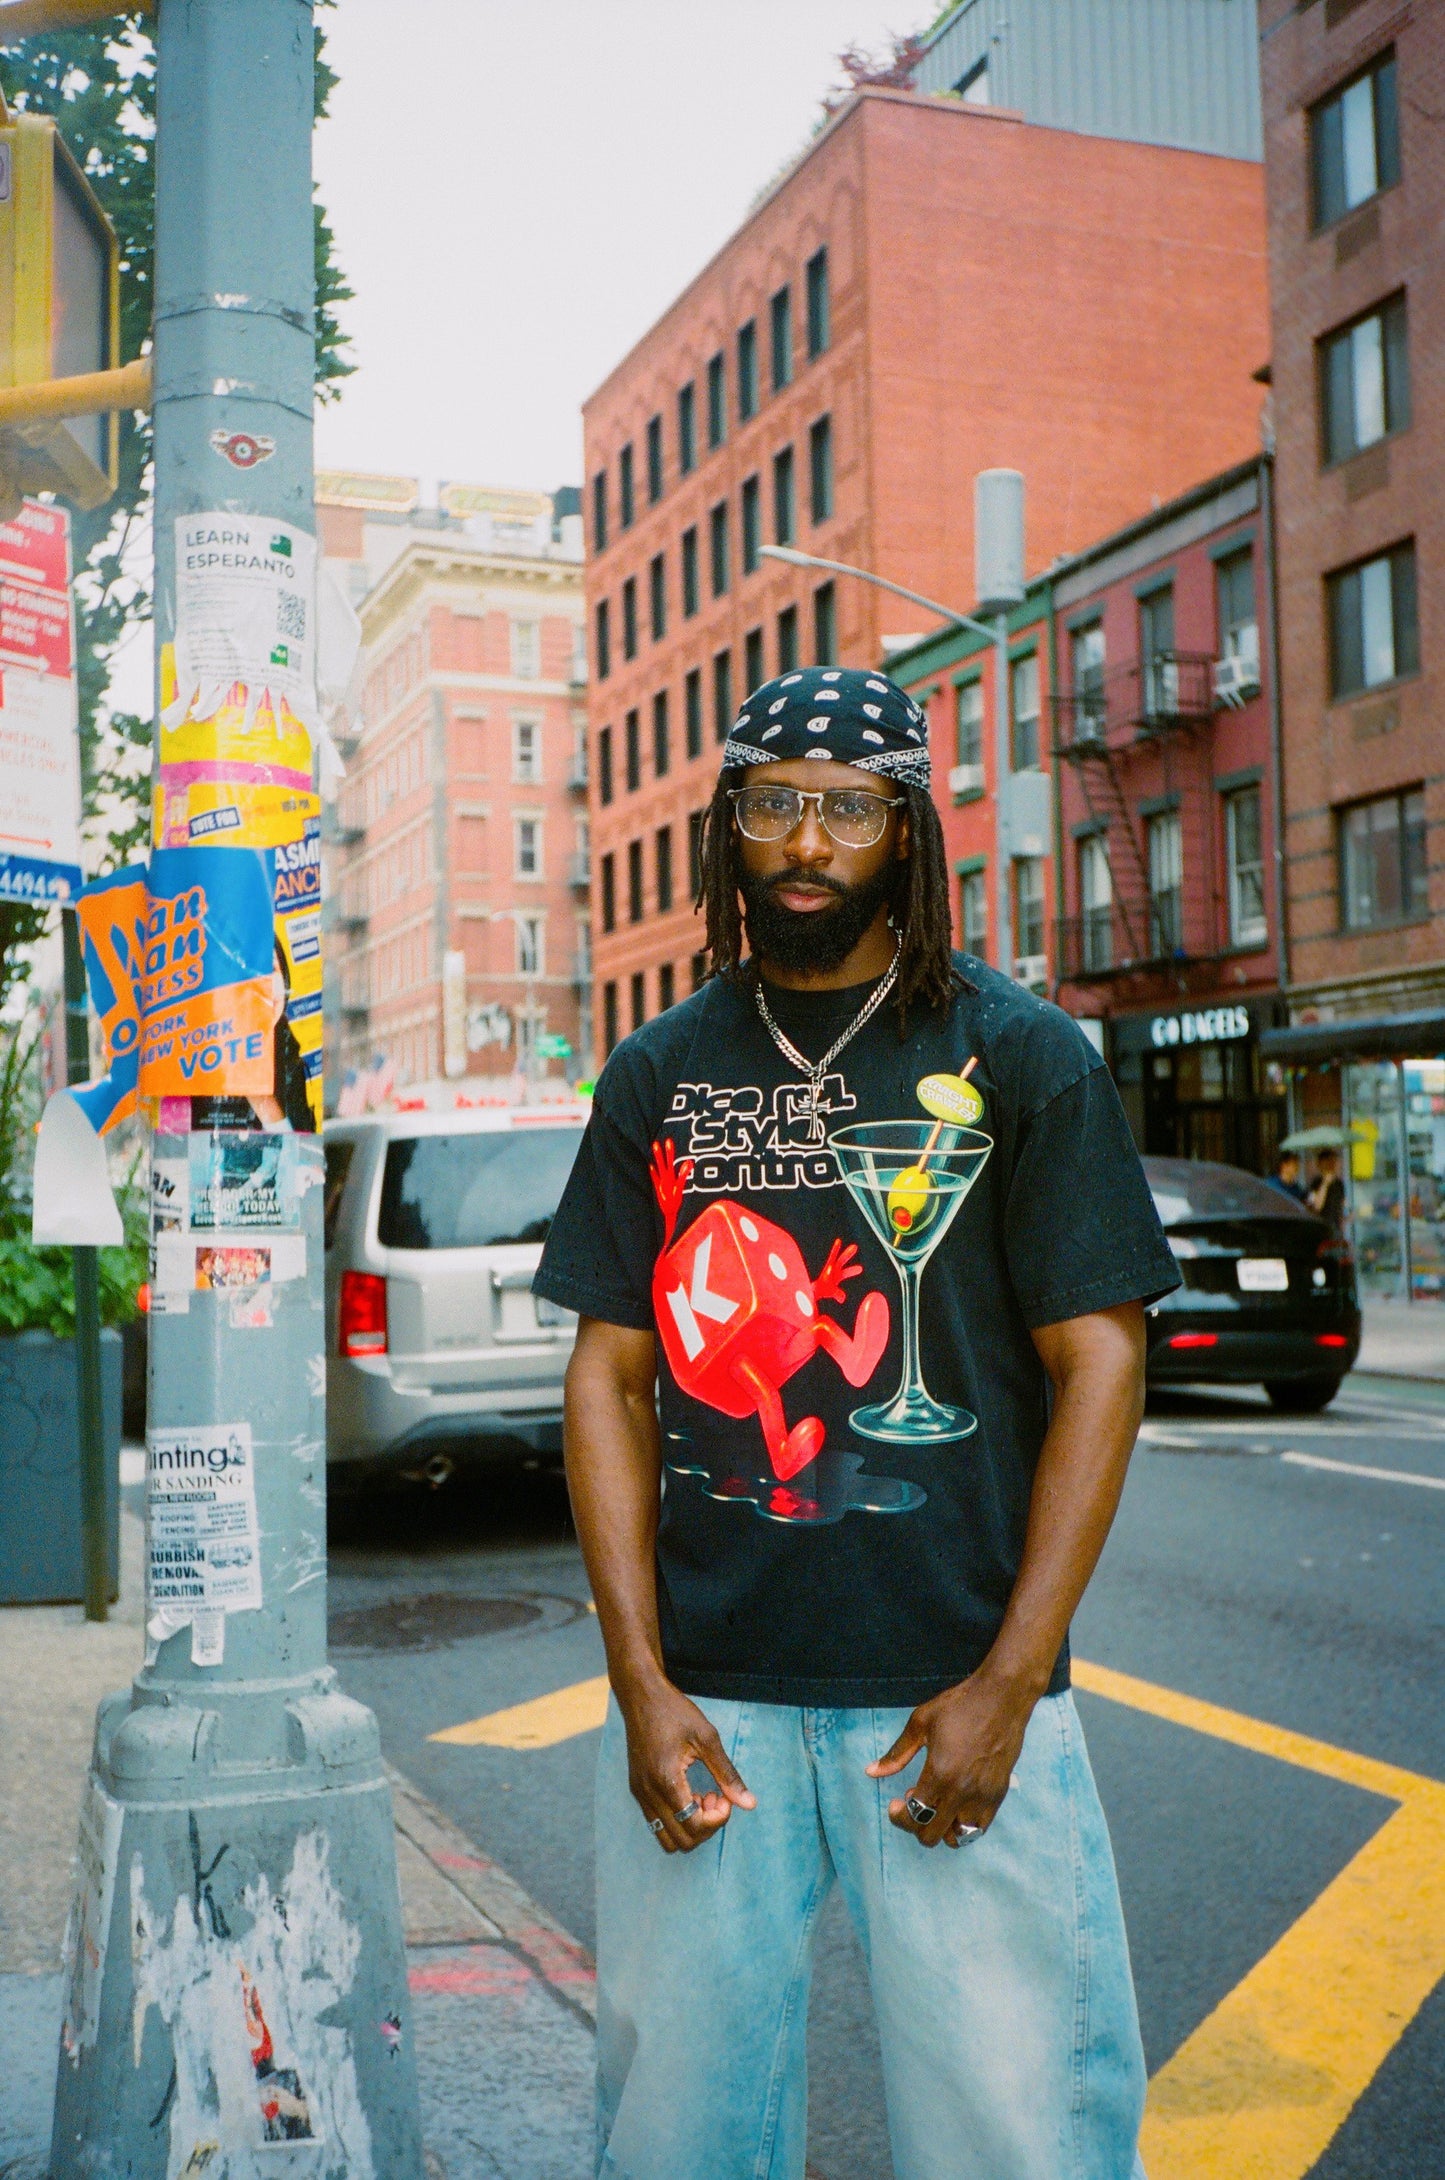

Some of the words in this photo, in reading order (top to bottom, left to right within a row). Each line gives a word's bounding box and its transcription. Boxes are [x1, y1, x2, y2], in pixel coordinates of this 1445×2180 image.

[186, 531, 249, 546] LEARN
[187, 554, 295, 578] ESPERANTO
[181, 1019, 233, 1048] YORK
[179, 1033, 263, 1078] VOTE
[666, 1231, 741, 1364] K
[166, 1472, 242, 1490] SANDING
